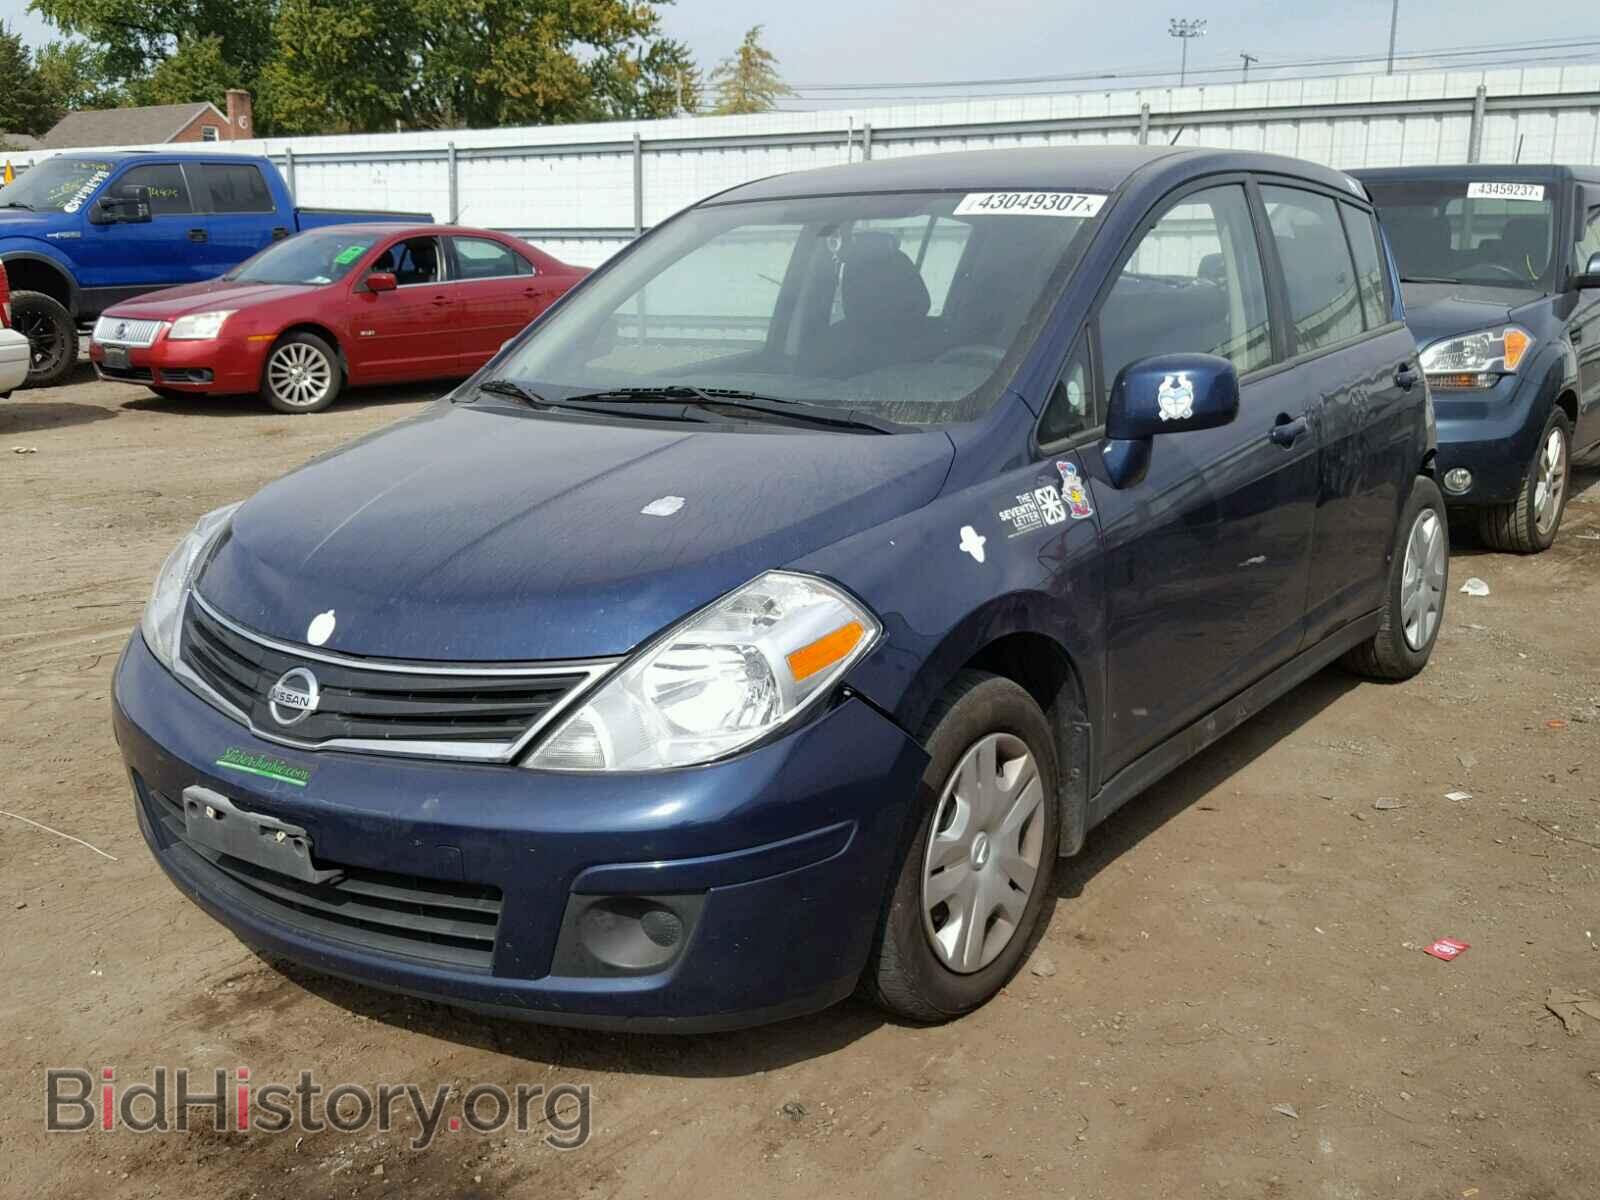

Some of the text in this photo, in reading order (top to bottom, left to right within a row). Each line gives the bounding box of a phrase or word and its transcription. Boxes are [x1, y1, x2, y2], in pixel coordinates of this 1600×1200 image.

[1015, 492, 1033, 505] THE
[998, 502, 1038, 521] SEVENTH
[1013, 511, 1041, 528] LETTER
[273, 688, 311, 706] NISSAN
